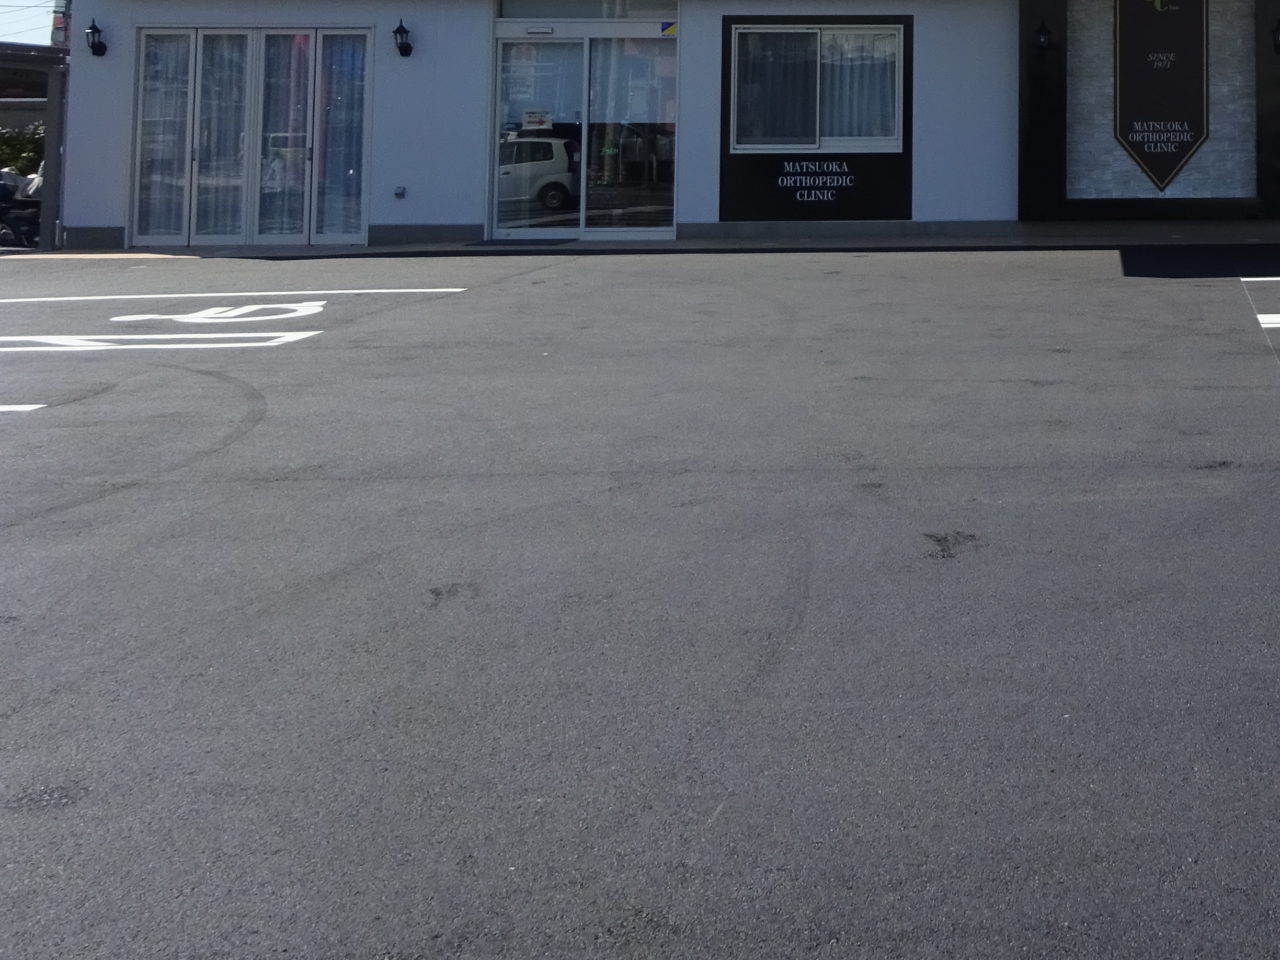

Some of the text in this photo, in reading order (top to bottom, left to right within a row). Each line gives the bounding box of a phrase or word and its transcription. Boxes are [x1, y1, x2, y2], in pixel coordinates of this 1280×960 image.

[1147, 52, 1176, 61] SINCE
[1133, 121, 1189, 131] MATSUOKA
[1128, 132, 1194, 142] ORTHOPEDIC
[1144, 143, 1178, 153] CLINIC
[784, 161, 849, 173] MATSUOKA
[778, 175, 855, 187] ORTHOPEDIC
[796, 189, 836, 201] CLINIC
